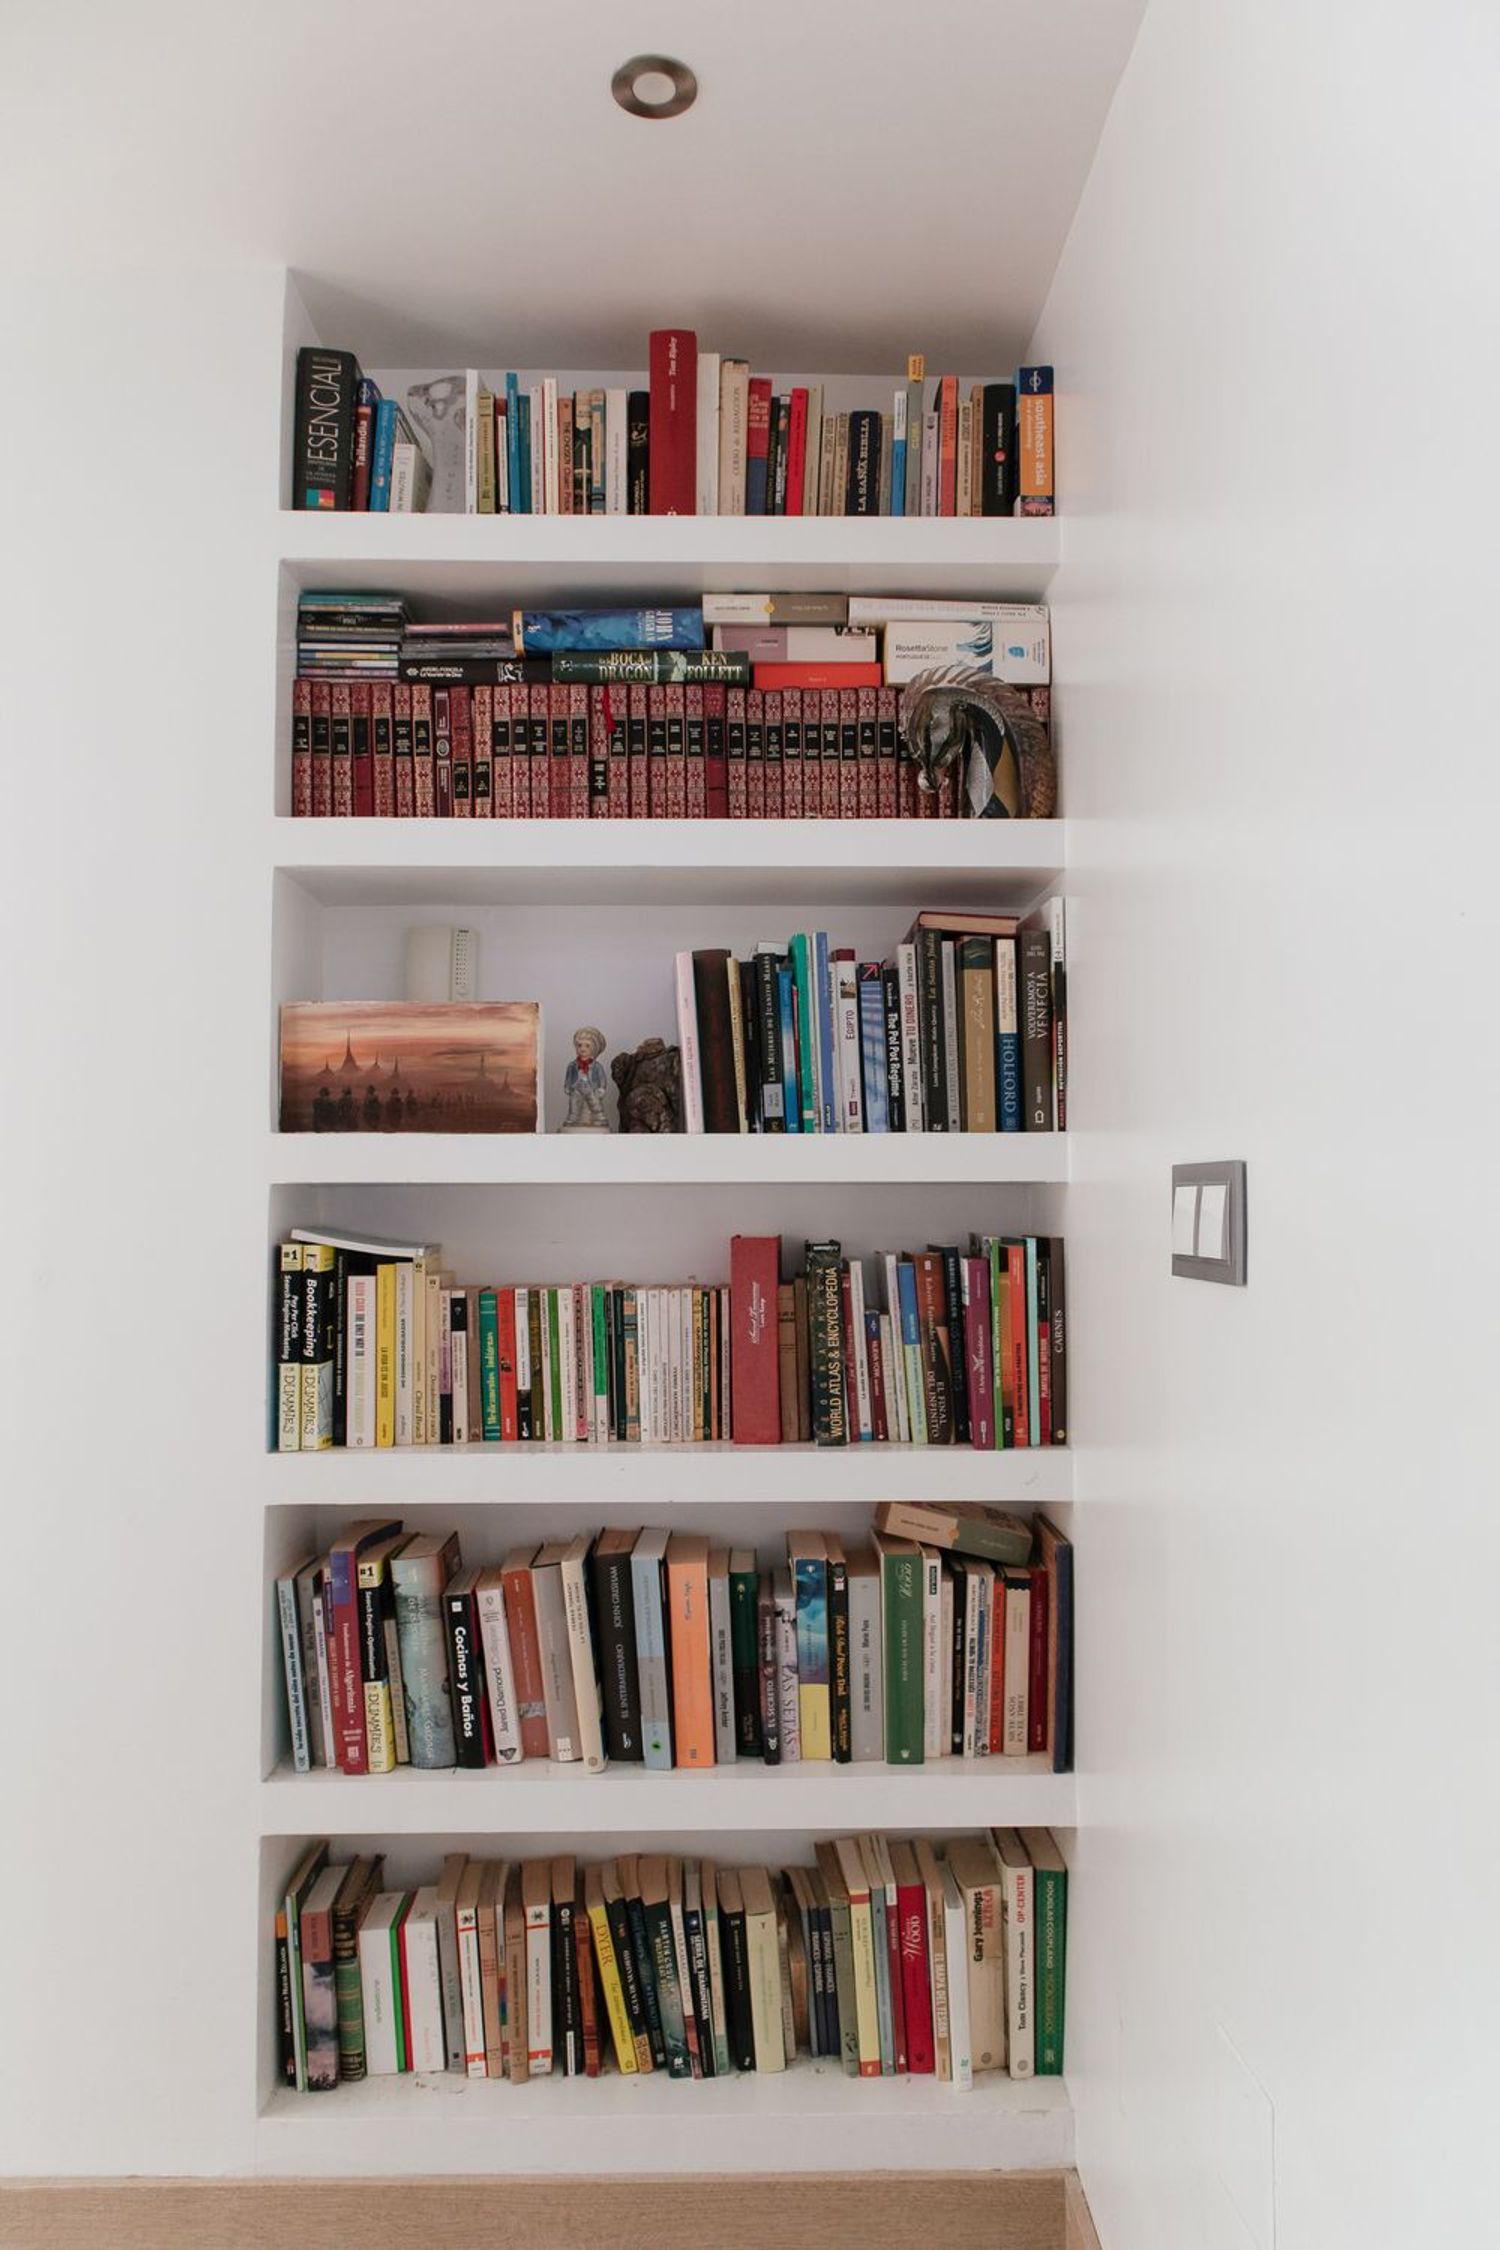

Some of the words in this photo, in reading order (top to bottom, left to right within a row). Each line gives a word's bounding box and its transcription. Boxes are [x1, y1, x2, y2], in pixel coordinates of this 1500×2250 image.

[307, 362, 341, 462] ESENCIAL
[356, 420, 368, 467] Tailandia
[860, 417, 869, 458] BIBLIA
[1035, 399, 1046, 458] southeast
[856, 459, 867, 494] SANTA
[1035, 462, 1046, 486] asia
[858, 496, 867, 512] LA
[611, 652, 645, 666] BOCA
[687, 666, 742, 681] FOLLETT
[702, 652, 728, 665] KEN
[1028, 971, 1035, 979] A
[765, 983, 774, 1016] JUANITO
[905, 994, 914, 1024] DINERO
[1027, 981, 1037, 1039] VOLVEREMOS
[1036, 971, 1048, 1040] VENECIA
[766, 1018, 774, 1028] DE
[845, 1010, 855, 1040] EGIPTO
[888, 1013, 898, 1029] The
[906, 1025, 915, 1036] TU
[766, 1030, 776, 1064] MUJERES
[888, 1031, 898, 1045] Pol
[889, 1046, 899, 1061] Pot
[907, 1038, 916, 1064] Mueve
[767, 1065, 776, 1081] LAS
[889, 1063, 901, 1097] Regime
[1002, 1039, 1017, 1113] HOLFORD
[304, 1279, 317, 1358] Bookkeeping
[825, 1267, 839, 1347] ENCYCLOPEDIA
[281, 1318, 290, 1360] Marketing
[291, 1320, 299, 1338] Click
[1055, 1309, 1063, 1353] CARNES
[829, 1348, 839, 1358] &
[828, 1361, 841, 1395] ATLAS
[926, 1370, 935, 1387] DEL
[936, 1382, 944, 1393] EL
[283, 1375, 295, 1435] DUMMIES
[304, 1376, 317, 1435] DUMMIES
[829, 1398, 843, 1437] WORLD
[928, 1389, 938, 1438] INFINITO
[938, 1395, 947, 1425] FINAL
[610, 1566, 621, 1604] GRISHAM
[365, 1591, 374, 1614] Search
[612, 1605, 624, 1629] JOHN
[366, 1614, 374, 1636] Engine
[454, 1626, 468, 1679] Cocinas
[458, 1682, 469, 1691] y
[492, 1667, 506, 1707] Diamond
[781, 1665, 798, 1693] LAS
[368, 1693, 382, 1754] DUMMIES
[460, 1695, 474, 1738] Baños
[498, 1709, 510, 1733] Jared
[783, 1698, 799, 1745] SETAS
[973, 1891, 983, 1936] Jennings
[1017, 1874, 1026, 1923] OP-CENTER
[1046, 1880, 1054, 1921] DOUGLAS
[596, 1923, 613, 1966] DYER
[659, 1920, 670, 1955] MARTIN
[694, 1934, 704, 1958] SERRA
[902, 1915, 921, 1961] WOOD
[973, 1938, 984, 1962] Gary
[1046, 1921, 1054, 1969] COUPLAND
[695, 1959, 704, 1968] DE
[934, 1953, 944, 1962] EL
[935, 1964, 945, 1988] MAPA
[697, 1970, 709, 2020] TRAMUNTANA
[935, 1990, 946, 2004] DEL
[1018, 1982, 1028, 2011] Clancy
[936, 2006, 947, 2038] TESORO
[1018, 2013, 1027, 2030] Tom
